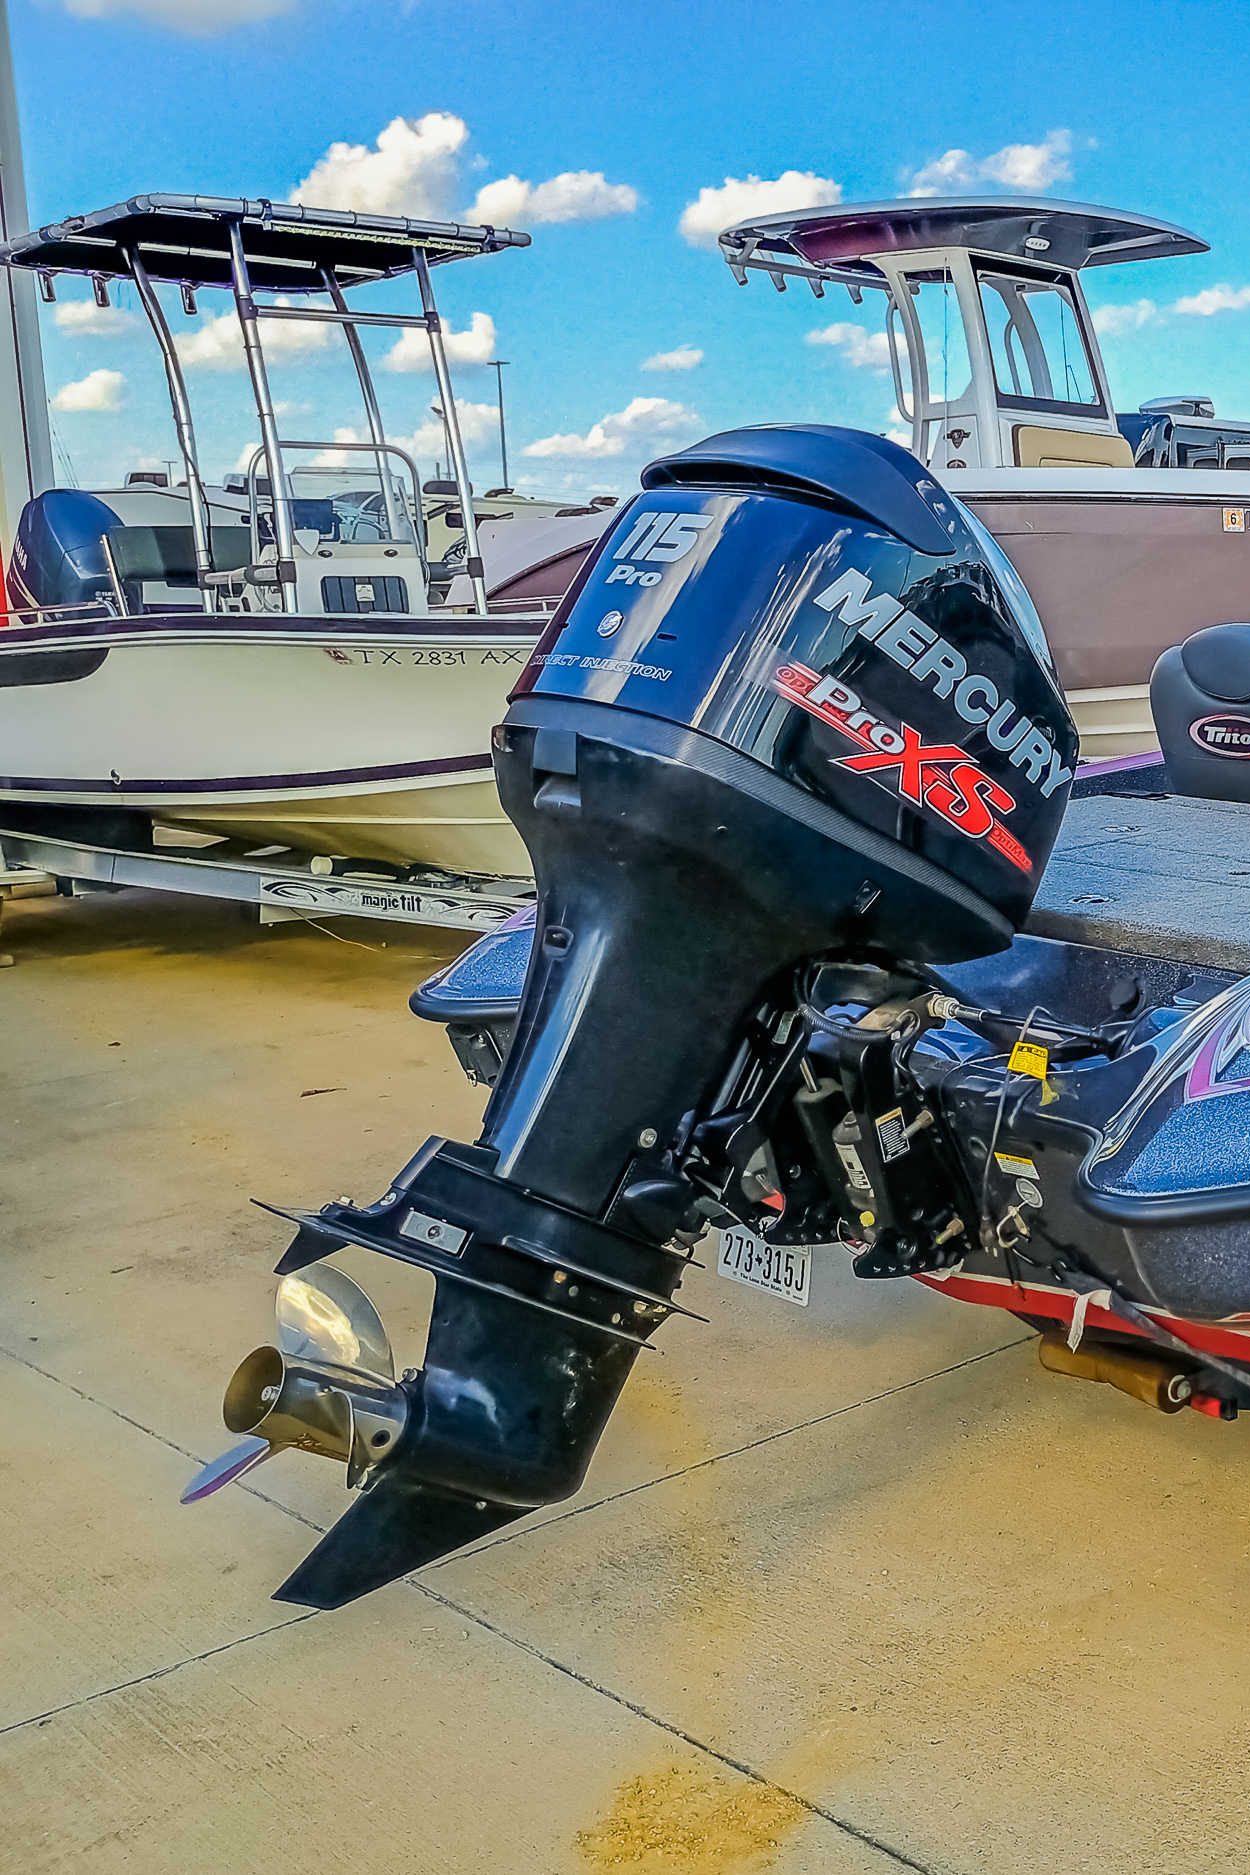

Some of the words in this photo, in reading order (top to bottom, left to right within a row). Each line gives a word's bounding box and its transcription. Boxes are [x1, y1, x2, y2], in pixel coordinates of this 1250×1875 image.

[612, 511, 716, 563] 115
[605, 564, 663, 587] Pro
[354, 650, 402, 665] TX
[411, 650, 466, 666] 2831
[480, 650, 525, 665] AX
[530, 654, 580, 667] DIRECT
[579, 656, 672, 682] INJECTION
[813, 567, 1073, 798] MERCURY
